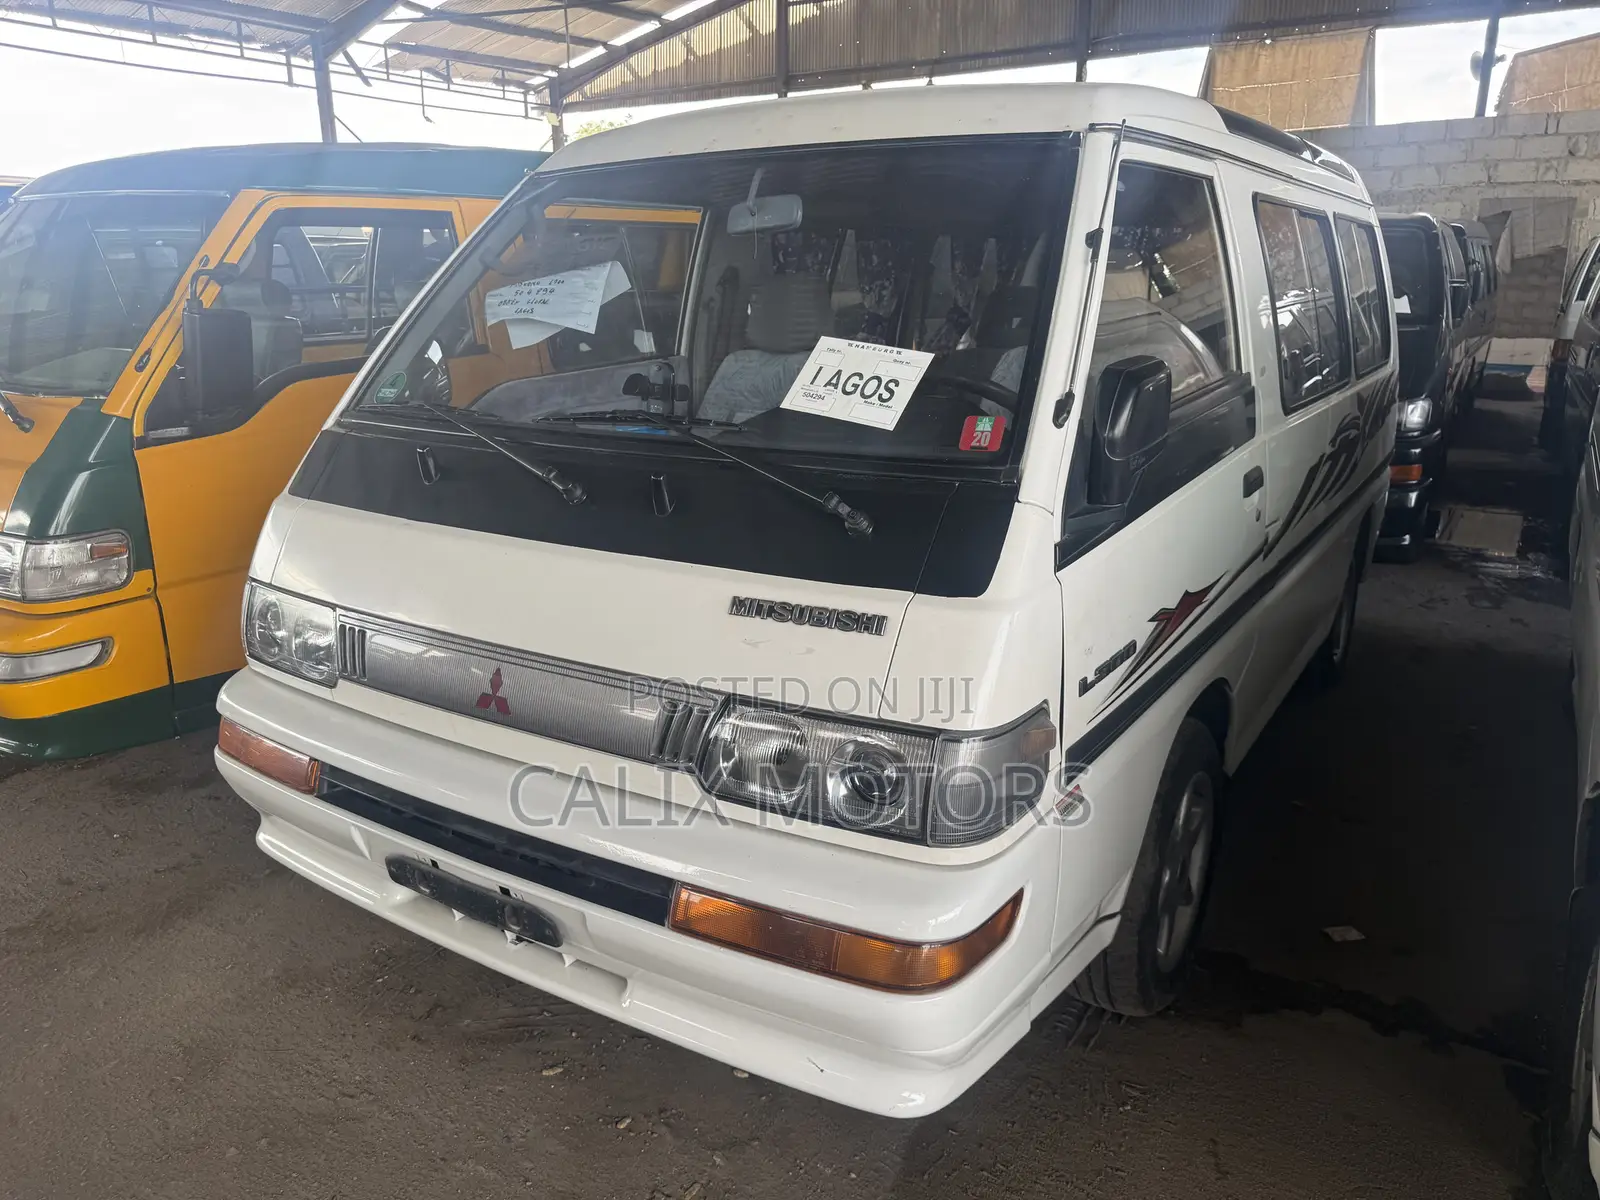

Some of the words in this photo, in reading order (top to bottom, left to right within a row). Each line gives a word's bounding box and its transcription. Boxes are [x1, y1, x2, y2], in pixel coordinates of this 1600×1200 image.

[802, 391, 826, 401] 504294
[970, 431, 991, 447] 20
[728, 595, 889, 637] MITSUBISHI
